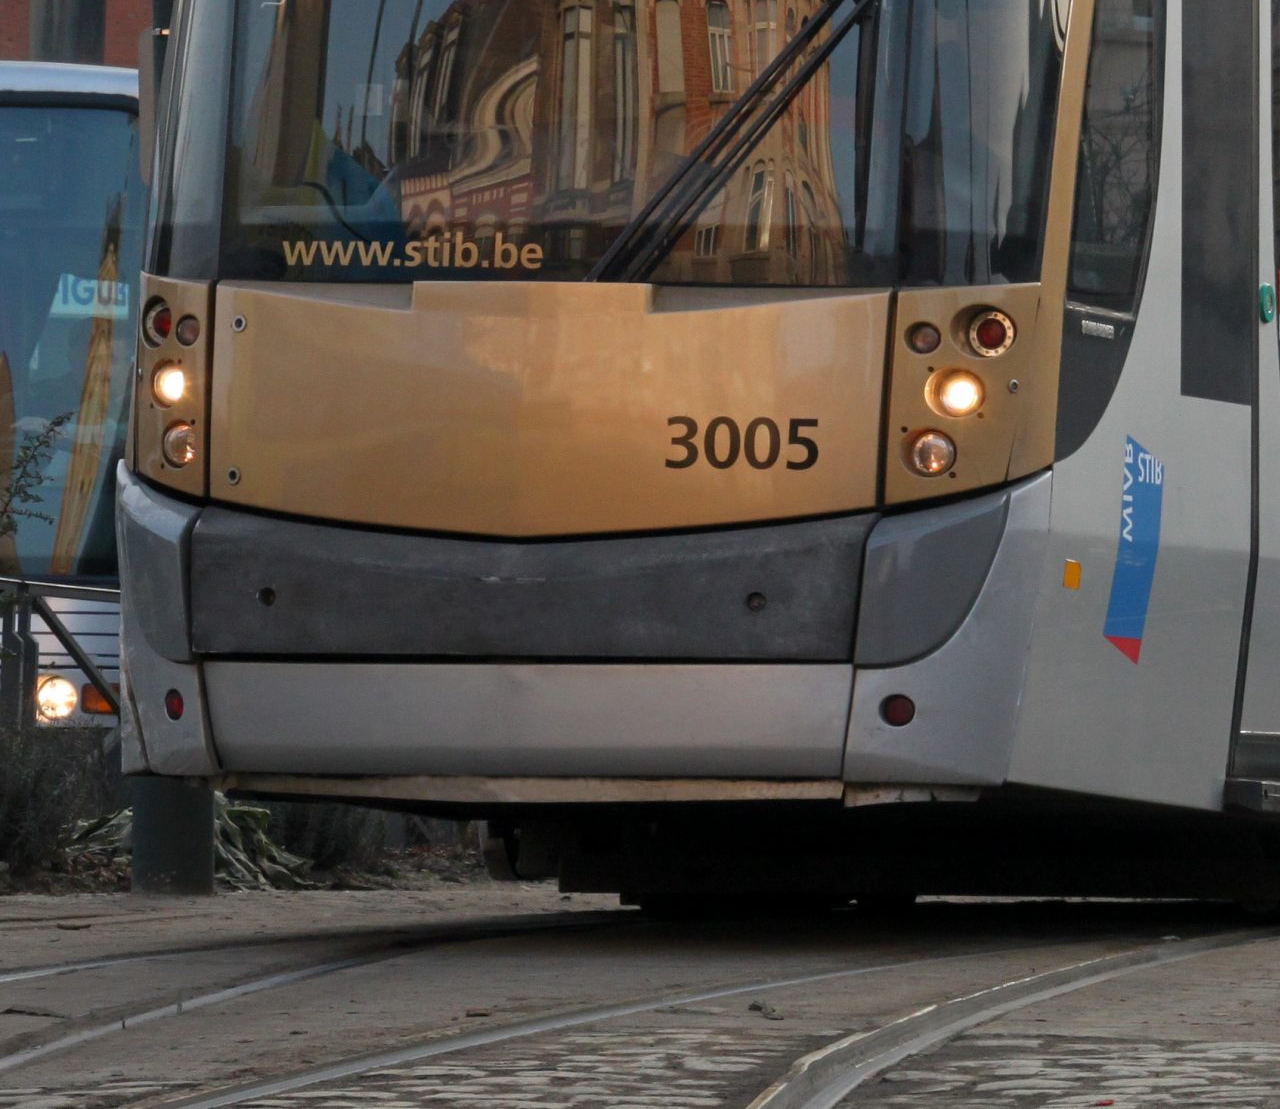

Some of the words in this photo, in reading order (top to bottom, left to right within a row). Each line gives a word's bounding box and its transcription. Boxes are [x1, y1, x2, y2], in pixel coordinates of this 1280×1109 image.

[282, 231, 545, 270] www.stib.be
[664, 415, 820, 471] 3005
[1138, 452, 1162, 485] STIB
